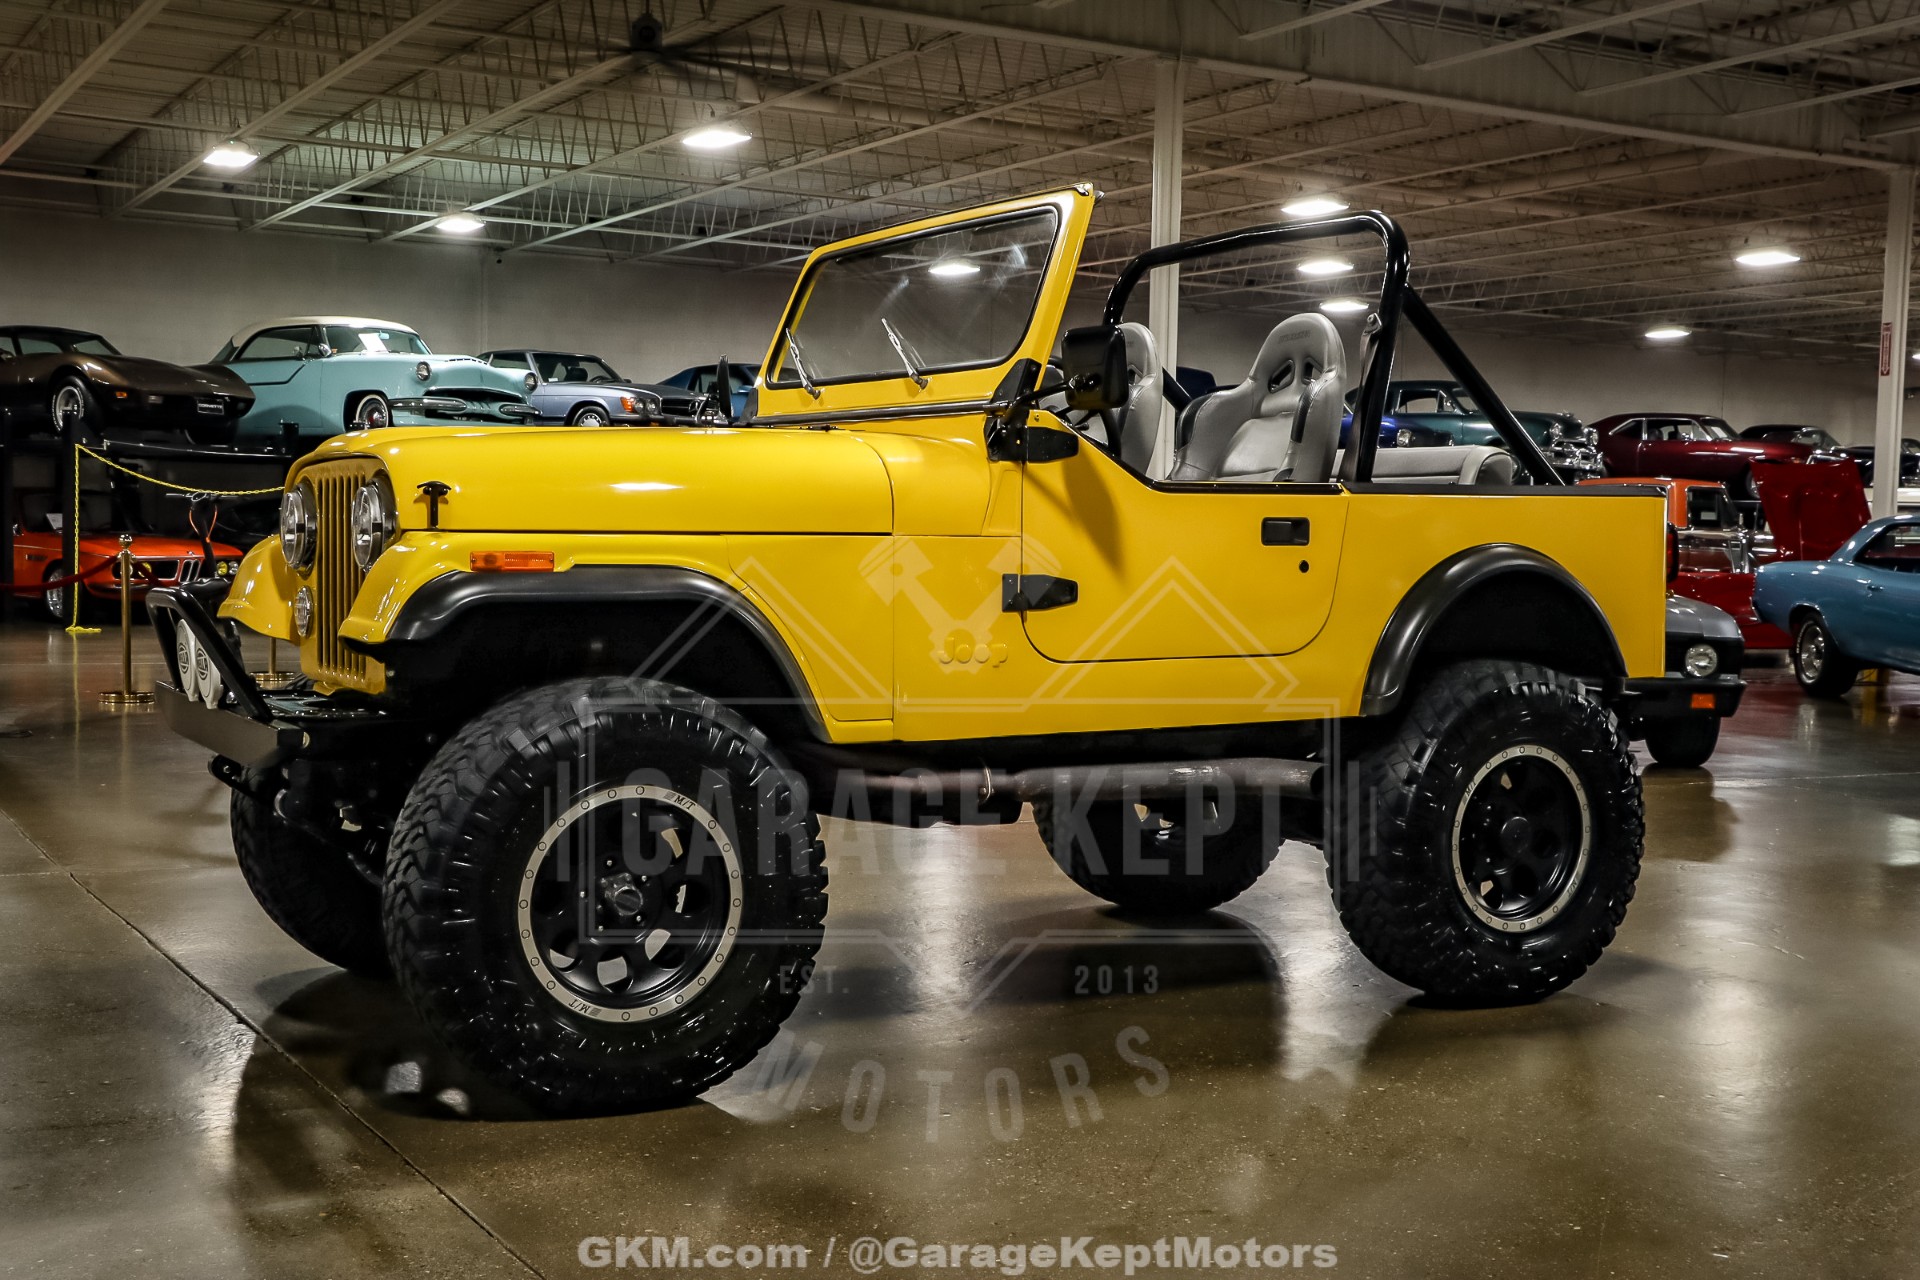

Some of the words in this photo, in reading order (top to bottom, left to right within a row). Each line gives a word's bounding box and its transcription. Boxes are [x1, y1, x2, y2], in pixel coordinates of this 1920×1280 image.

[937, 636, 1008, 668] Jeep
[673, 794, 696, 811] M/T
[568, 999, 591, 1014] M/T
